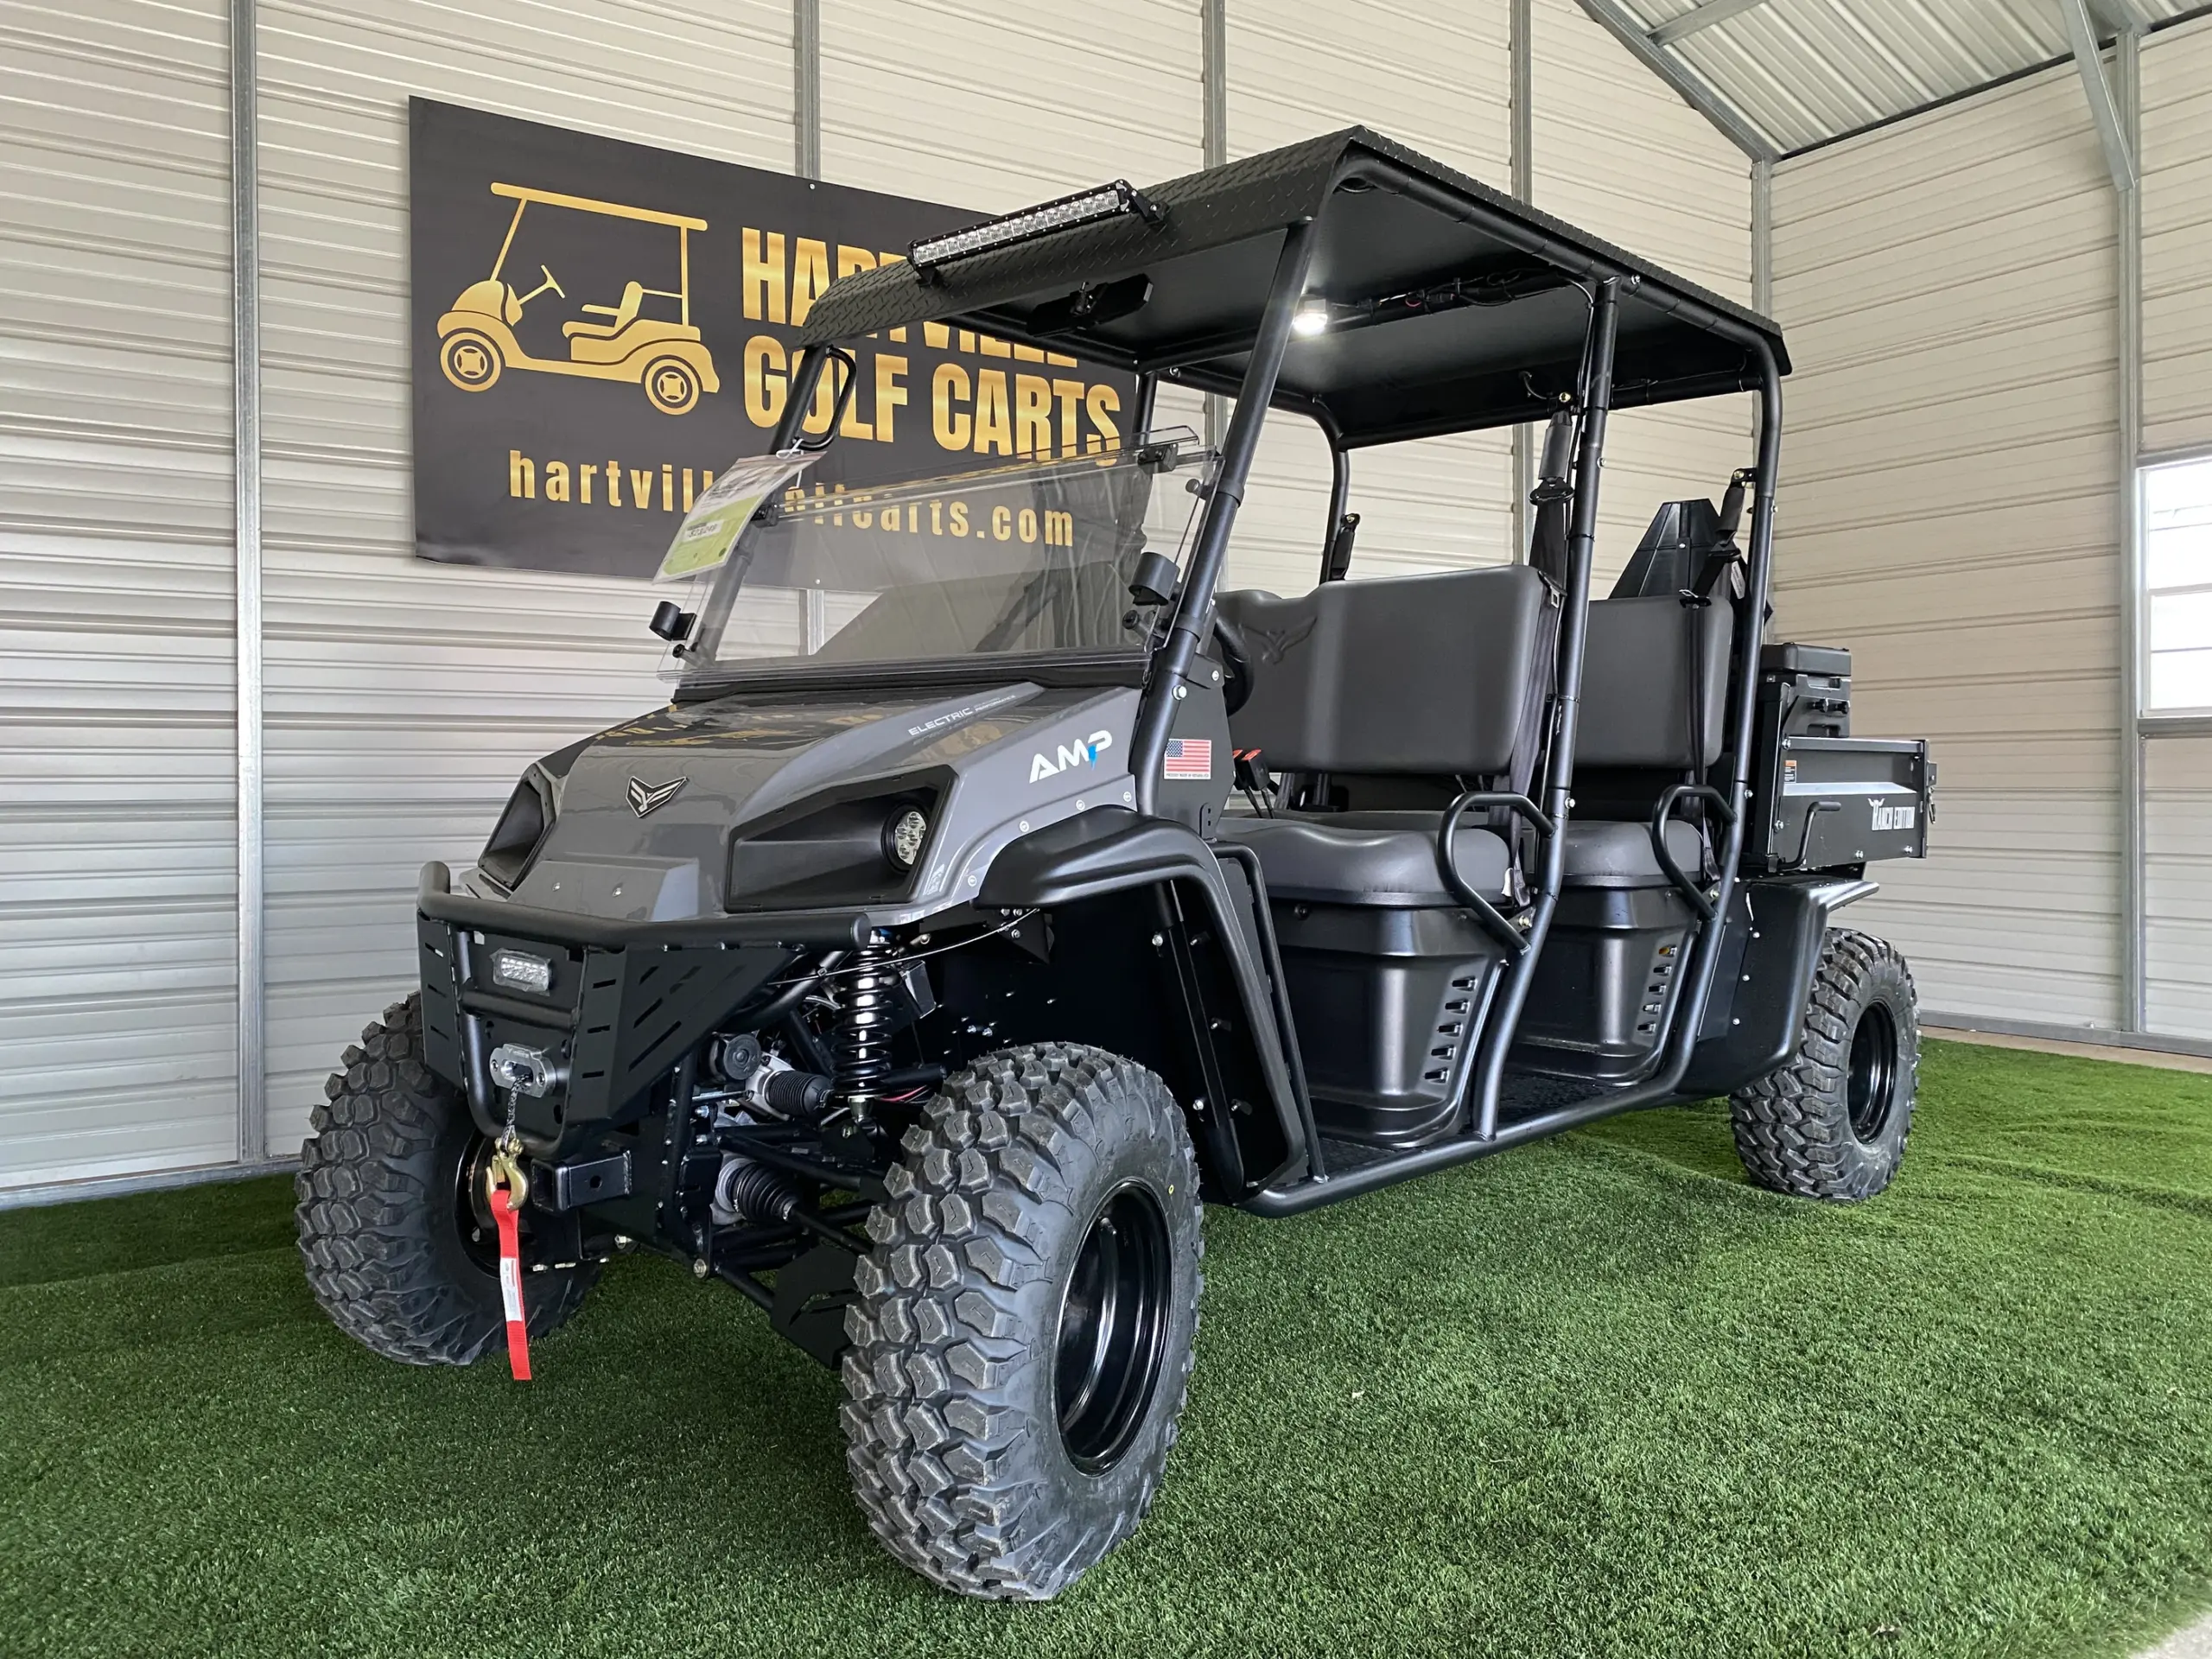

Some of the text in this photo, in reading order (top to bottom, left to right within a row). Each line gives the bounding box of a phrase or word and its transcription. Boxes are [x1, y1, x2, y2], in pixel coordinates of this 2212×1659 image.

[742, 334, 1121, 467] GOLF CARTS
[907, 707, 974, 736] ELECTRIC
[1028, 729, 1113, 785] AMP
